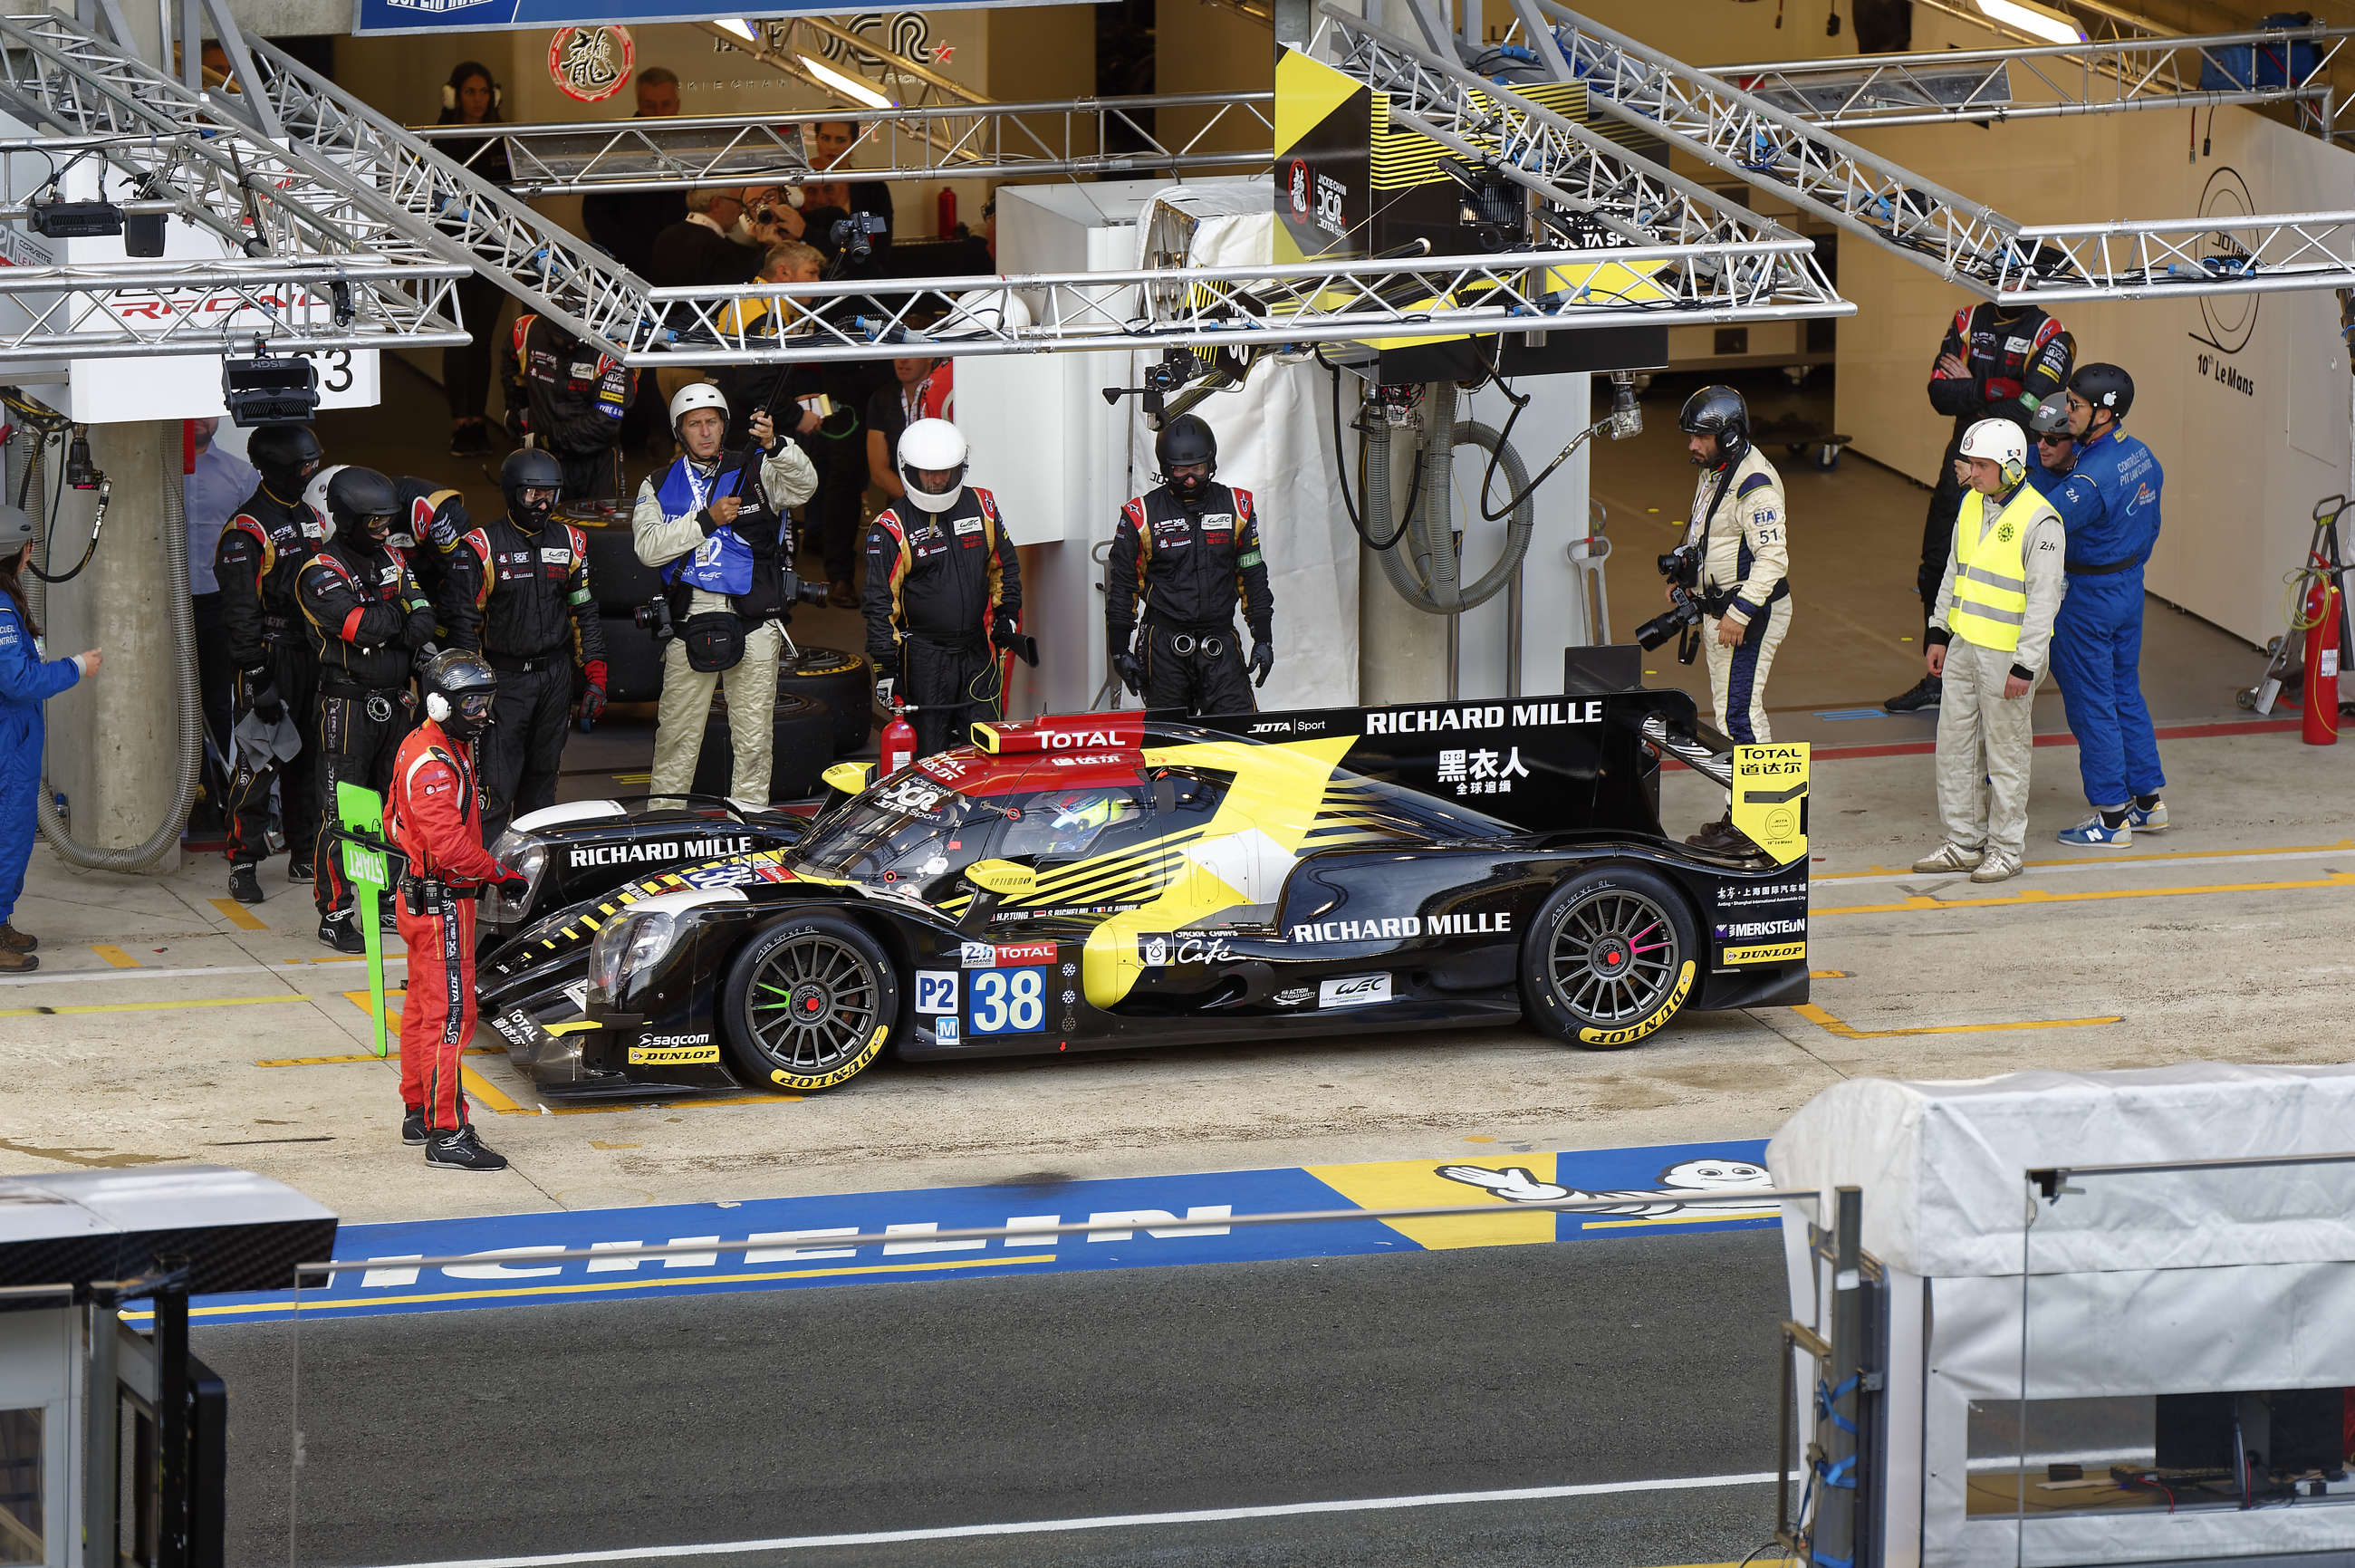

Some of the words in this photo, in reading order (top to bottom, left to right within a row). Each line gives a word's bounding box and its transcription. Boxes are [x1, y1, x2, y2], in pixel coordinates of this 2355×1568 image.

[18, 239, 53, 265] CORVETTE
[2216, 361, 2227, 384] Le
[2227, 366, 2254, 397] Mans
[1754, 511, 1775, 524] FIA
[1759, 528, 1779, 545] 51
[1246, 722, 1291, 734] JOTA
[1297, 720, 1326, 732] Sport
[1366, 706, 1504, 736] RICHARD
[1512, 700, 1603, 726] MILLE
[1033, 729, 1127, 750] TOTAL
[1437, 746, 1530, 783] 黑衣人
[1740, 747, 1802, 760] TOTAL
[1740, 762, 1802, 776] 道达尔
[928, 784, 955, 798] CHAN
[873, 798, 908, 814] JOTA
[908, 807, 942, 822] Sport
[570, 842, 679, 868] RICHARD
[684, 836, 754, 859] MILLE
[348, 849, 385, 885] START
[1293, 917, 1421, 943] RICHARD
[1427, 912, 1512, 936] MILLE
[997, 947, 1054, 959] TOTAL
[1178, 938, 1247, 965] Café
[1739, 947, 1802, 959] DUNLOP
[450, 970, 459, 1003] JOTA
[919, 976, 955, 1008] P2
[1335, 976, 1386, 996] WEC
[974, 969, 1043, 1032] 38
[508, 1008, 539, 1043] TOTAL
[1590, 986, 1686, 1044] DUNLOP
[652, 1033, 709, 1048] sagcom
[939, 1021, 956, 1037] M
[644, 1049, 717, 1062] DUNLOP
[780, 1049, 873, 1089] DUNLOP
